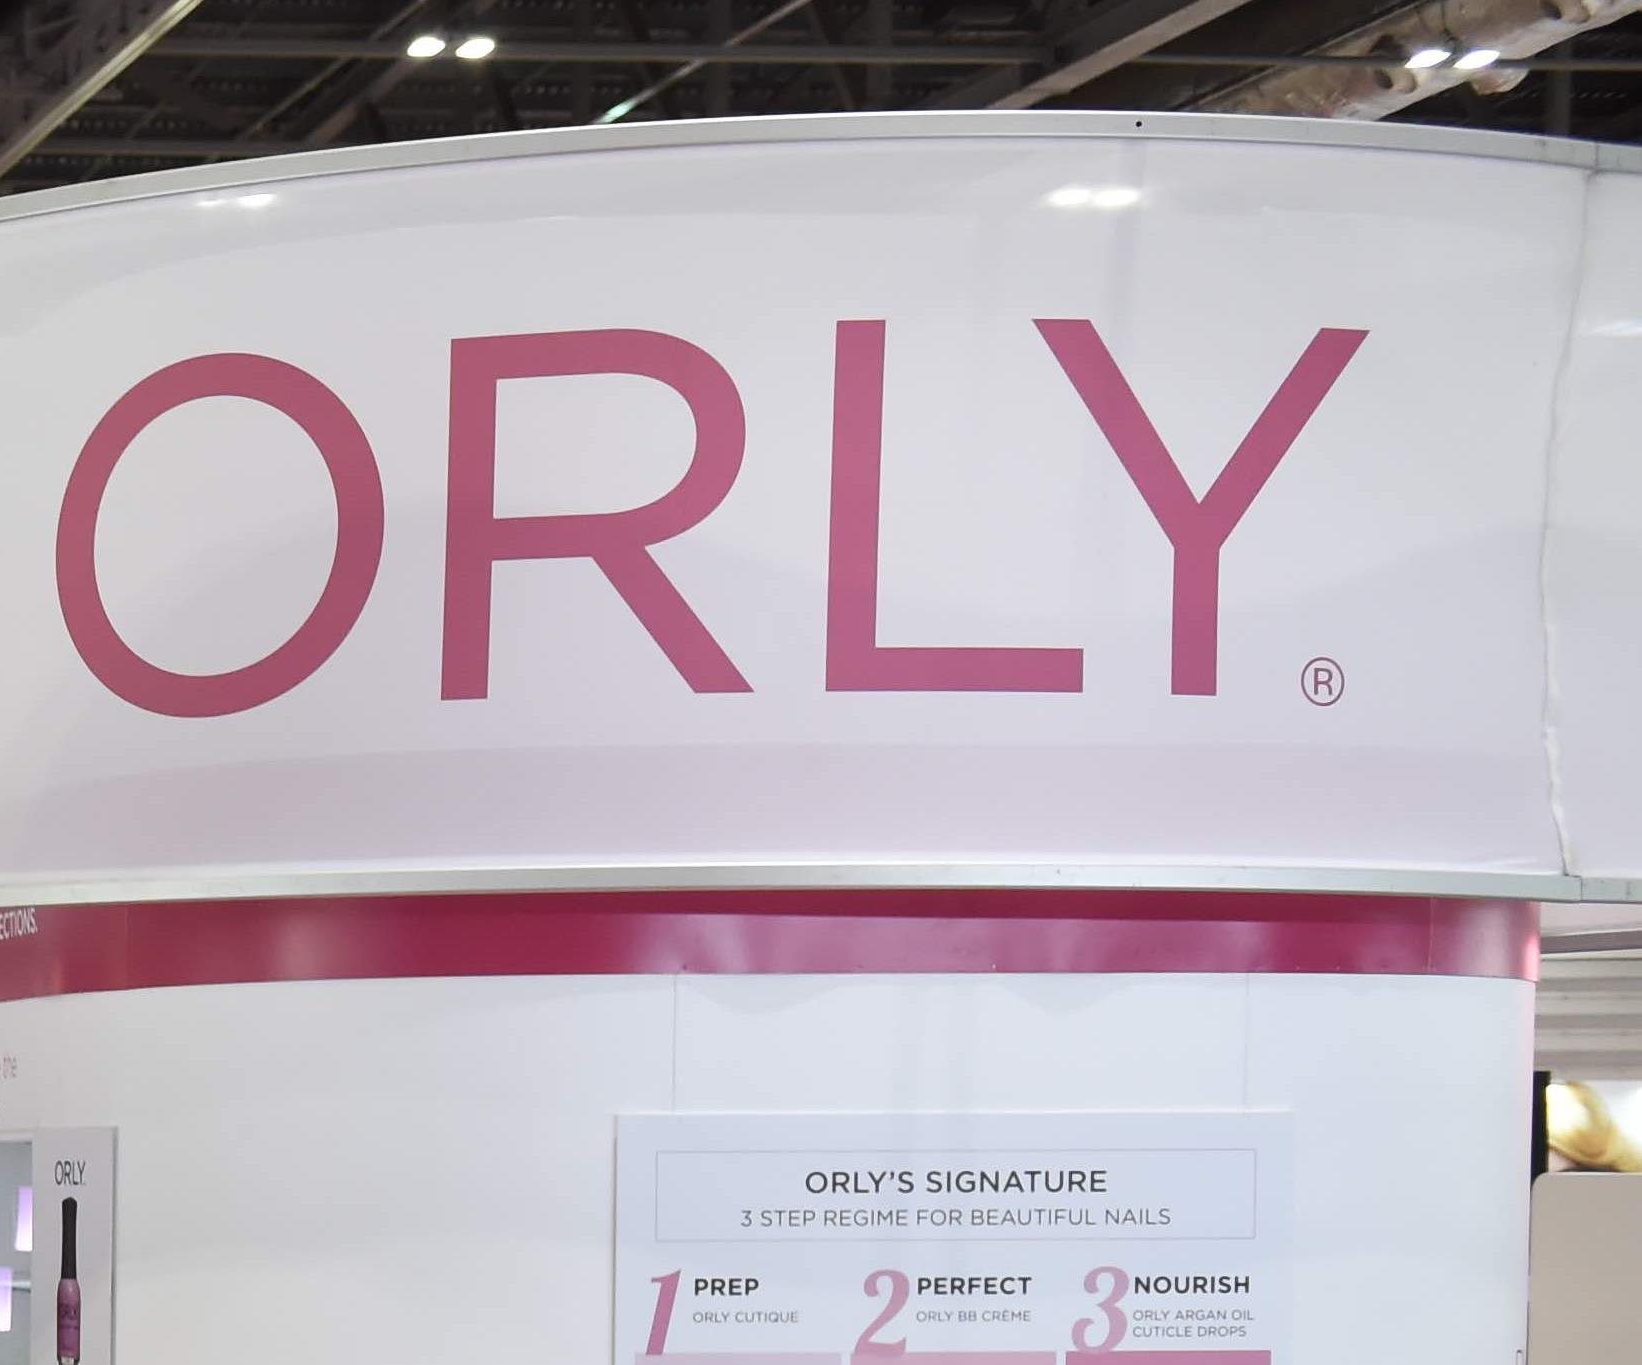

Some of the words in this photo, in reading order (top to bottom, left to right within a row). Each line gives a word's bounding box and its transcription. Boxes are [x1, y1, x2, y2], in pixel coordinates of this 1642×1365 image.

[925, 1169, 1108, 1194] SIGNATURE
[740, 1209, 754, 1228] 3
[760, 1209, 816, 1228] STEP
[822, 1208, 909, 1227] REGIME
[916, 1208, 963, 1227] FOR
[970, 1208, 1097, 1226] BEAUTIFUL
[1104, 1207, 1172, 1225] NAILS
[645, 1268, 682, 1356] 1
[693, 1277, 760, 1297] PREP
[692, 1311, 730, 1324] ORLY
[734, 1310, 799, 1324] CUTIQUE
[853, 1268, 910, 1356] 2
[917, 1276, 1033, 1296] PERFECT
[916, 1310, 954, 1323] ORLY
[957, 1310, 978, 1322] BB
[1071, 1265, 1130, 1355] 3
[1133, 1275, 1251, 1295] NOURISH
[1132, 1309, 1169, 1322] ORLY
[1174, 1309, 1228, 1321] ARGAN
[1230, 1309, 1255, 1321] OIL
[1132, 1325, 1193, 1338] CUTICLE
[1197, 1325, 1247, 1338] DROPS
